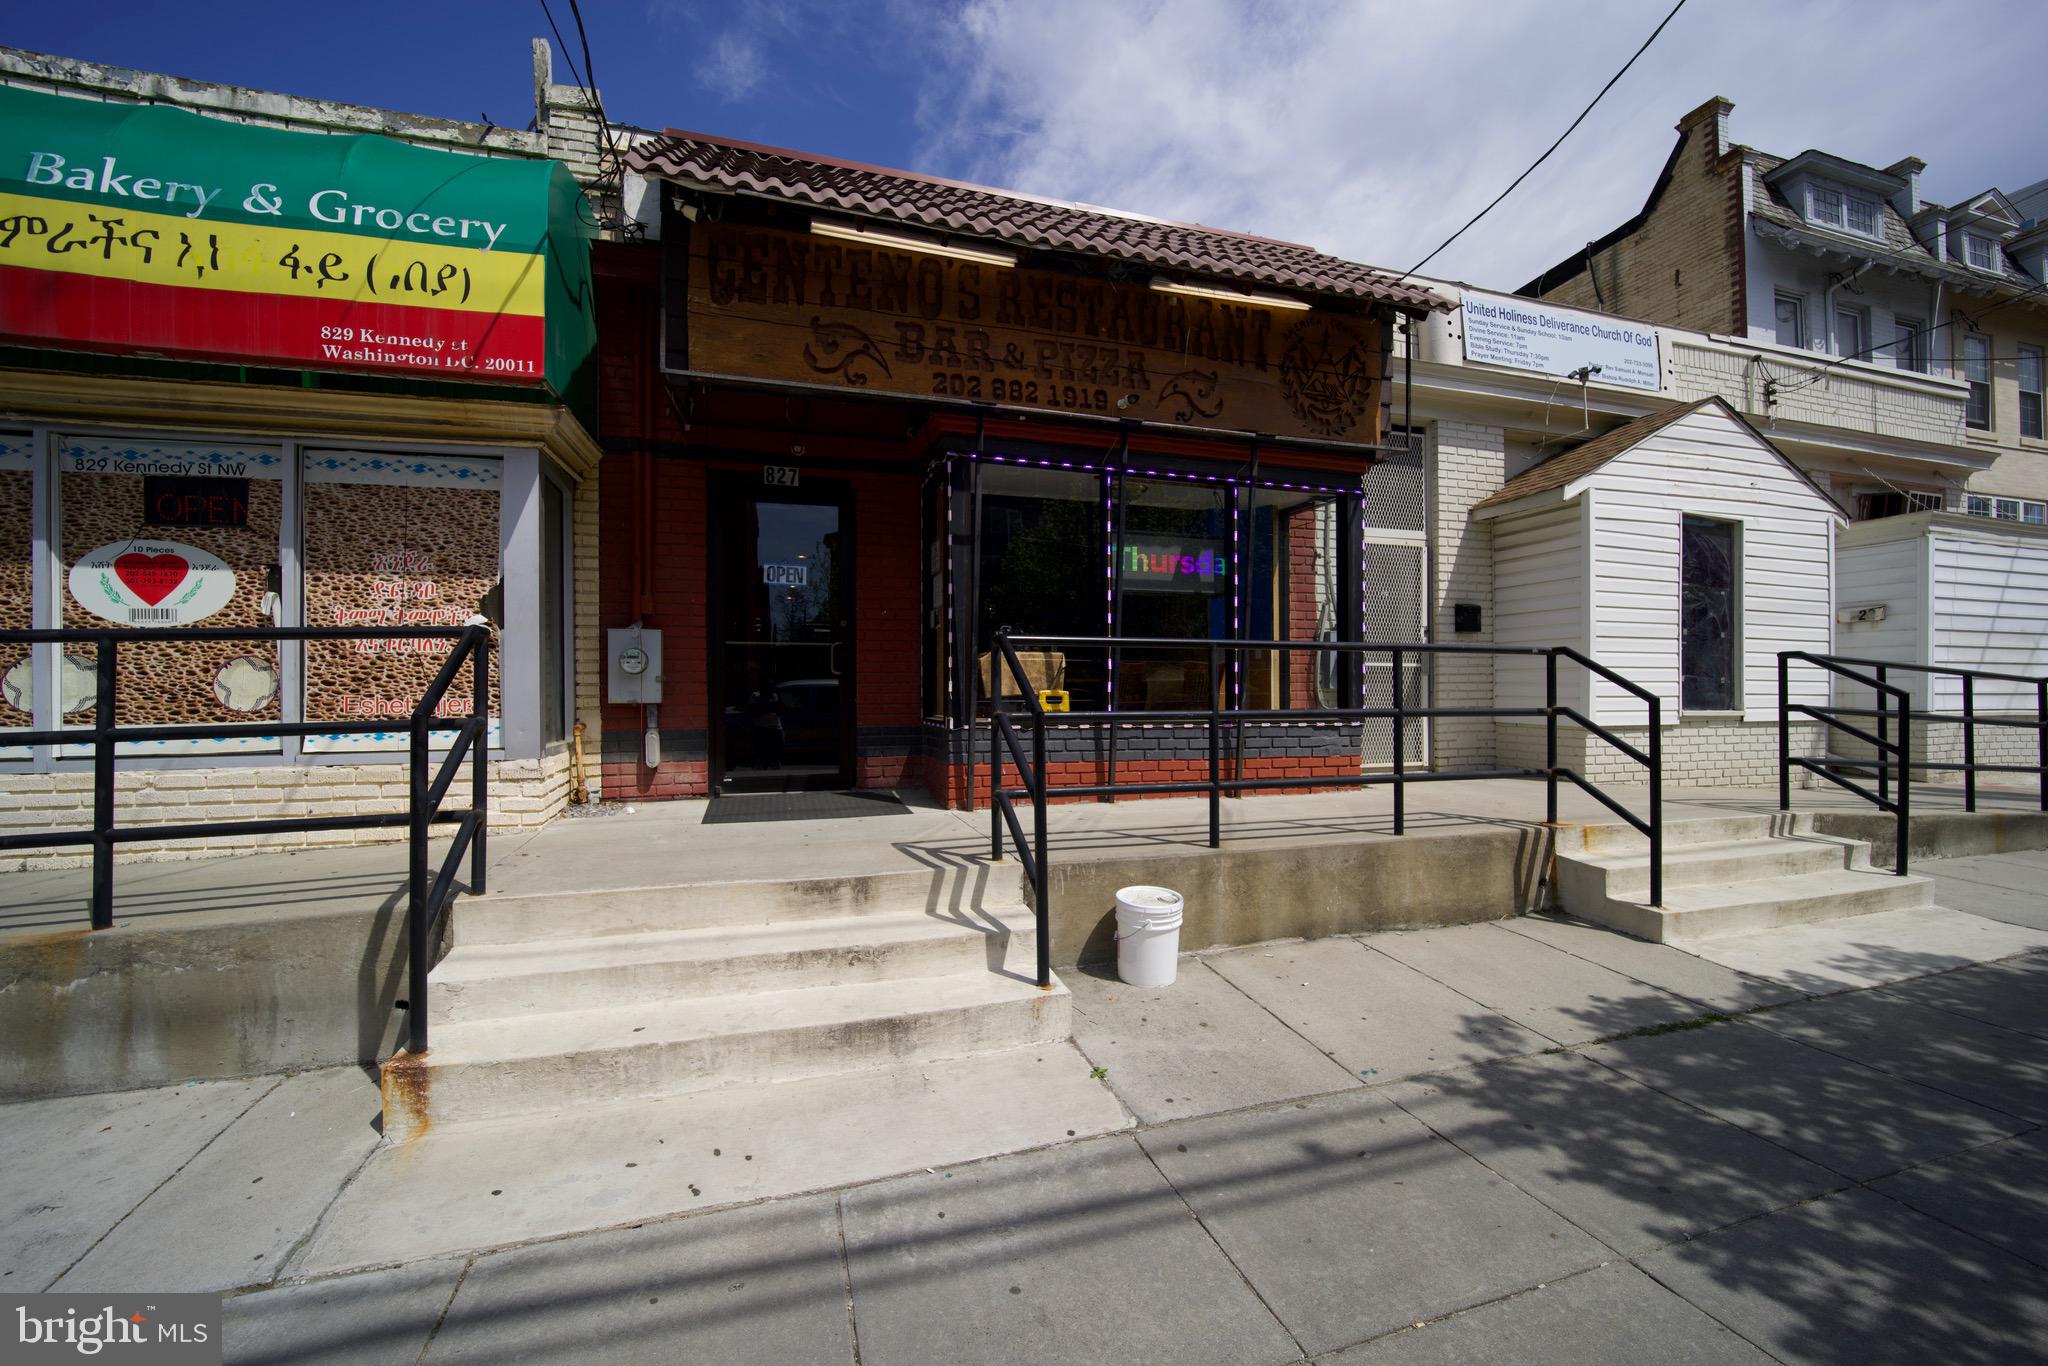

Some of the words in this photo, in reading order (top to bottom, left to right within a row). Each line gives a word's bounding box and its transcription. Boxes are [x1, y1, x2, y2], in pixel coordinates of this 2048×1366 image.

[26, 151, 221, 219] Bakery
[242, 183, 283, 216] &
[309, 189, 507, 252] Grocery
[995, 269, 1270, 371] RESTAURANT
[1466, 301, 1497, 318] United
[1499, 307, 1538, 326] Holiness
[1540, 314, 1590, 336] Deliverance
[1591, 324, 1622, 342] Church
[1623, 331, 1633, 343] Of
[1635, 333, 1652, 347] God
[1468, 317, 1489, 328] Sunday
[1489, 321, 1511, 331] Service
[1517, 326, 1537, 337] Sunday
[321, 326, 353, 341] 829
[360, 328, 445, 351] Kennedy
[1468, 325, 1486, 335] Divine
[1486, 329, 1508, 339] Service:
[1510, 333, 1526, 341] 11am
[1469, 333, 1492, 344] Evening
[1492, 337, 1514, 347] Service:
[894, 321, 995, 372] BAR
[1003, 343, 1025, 370] &
[1033, 339, 1150, 390] PIZZA
[1470, 341, 1485, 351] Bible
[1504, 347, 1529, 359] Thursday
[1470, 350, 1489, 360] Prayer
[1514, 357, 1532, 368] Friday
[485, 357, 535, 373] 20011
[932, 372, 982, 398] 202
[992, 378, 1038, 403] 882
[1046, 384, 1108, 410] 1919
[75, 458, 107, 472] 829
[114, 458, 192, 477] Kennedy
[197, 462, 215, 475] St
[217, 464, 246, 476] NW
[766, 467, 798, 485] 827
[154, 491, 248, 526] OPEN
[1111, 546, 1226, 576] Thursda
[766, 566, 804, 583] OPEN
[344, 695, 412, 714] Eshet
